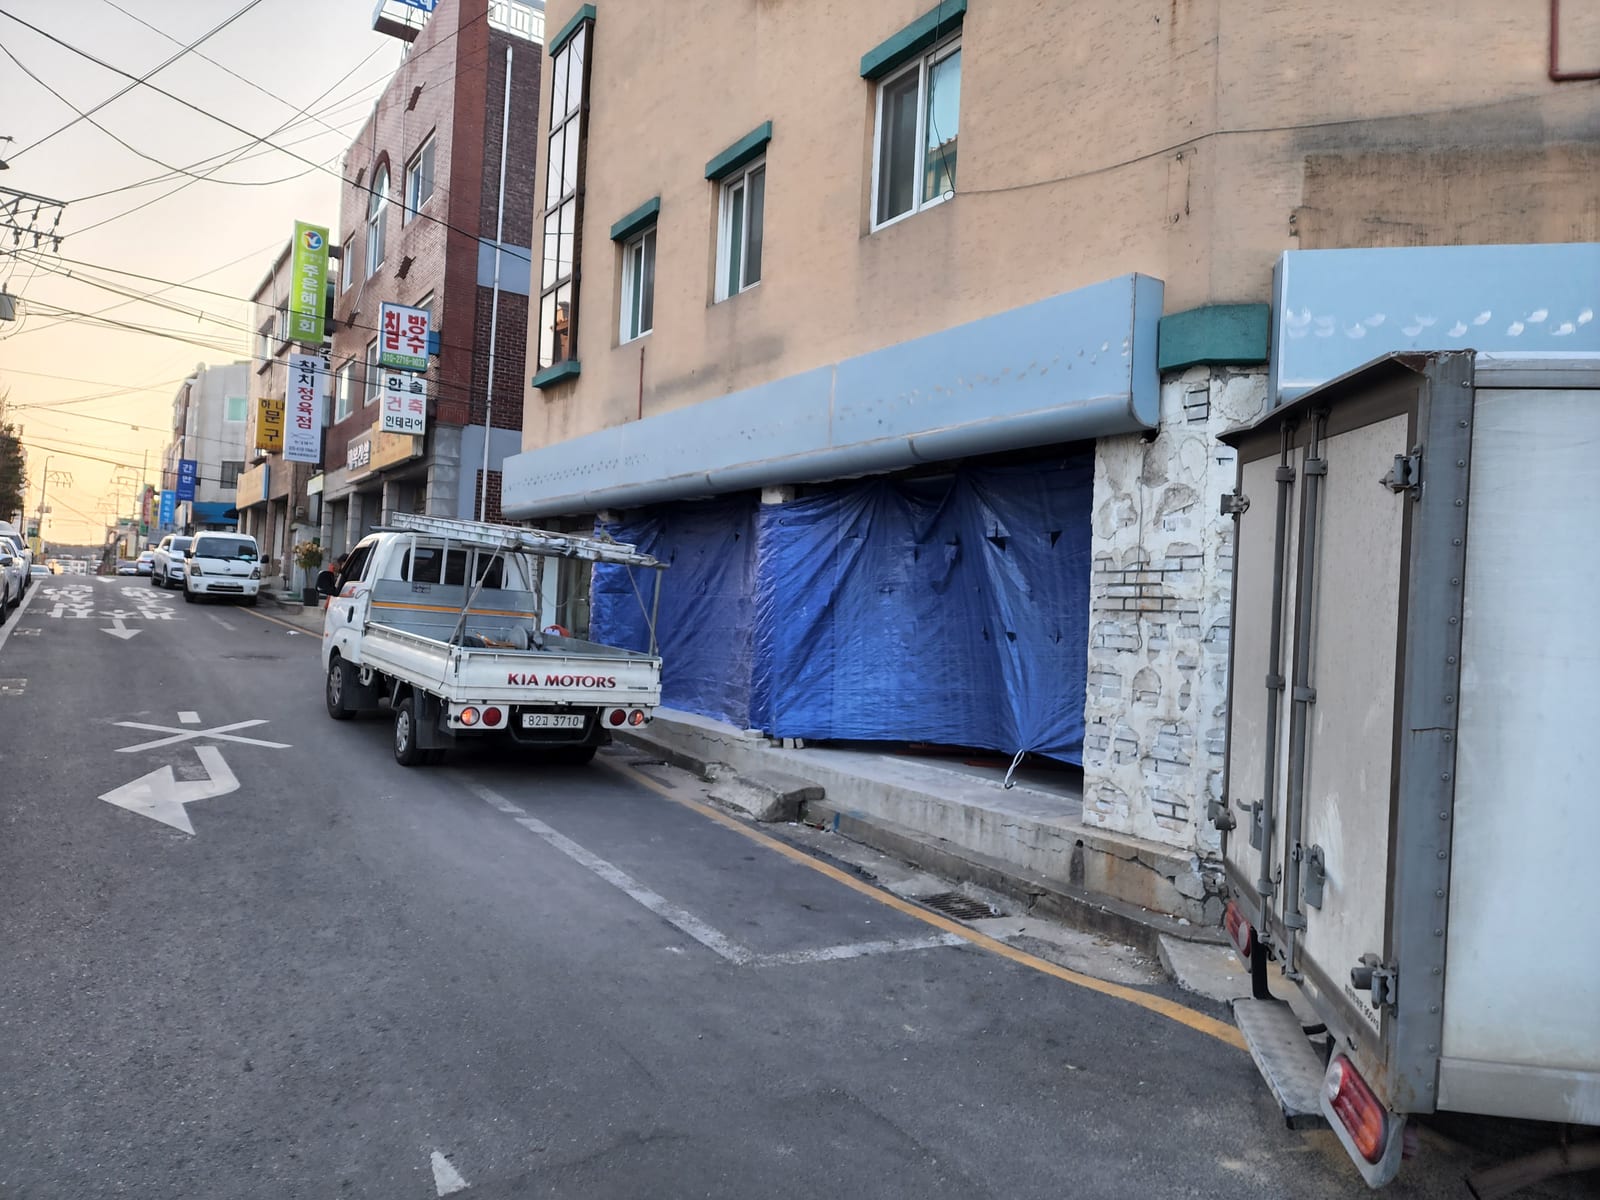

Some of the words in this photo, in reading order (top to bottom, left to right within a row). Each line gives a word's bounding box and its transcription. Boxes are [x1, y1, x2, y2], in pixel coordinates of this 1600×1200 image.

[299, 264, 318, 334] 주은혜교회
[407, 315, 428, 354] 방수
[296, 360, 318, 430] 참치정육점
[385, 415, 423, 431] 인테리어
[507, 672, 539, 686] KIA
[544, 674, 617, 689] MOTORS
[528, 715, 549, 726] 82고
[552, 715, 579, 727] 3710
